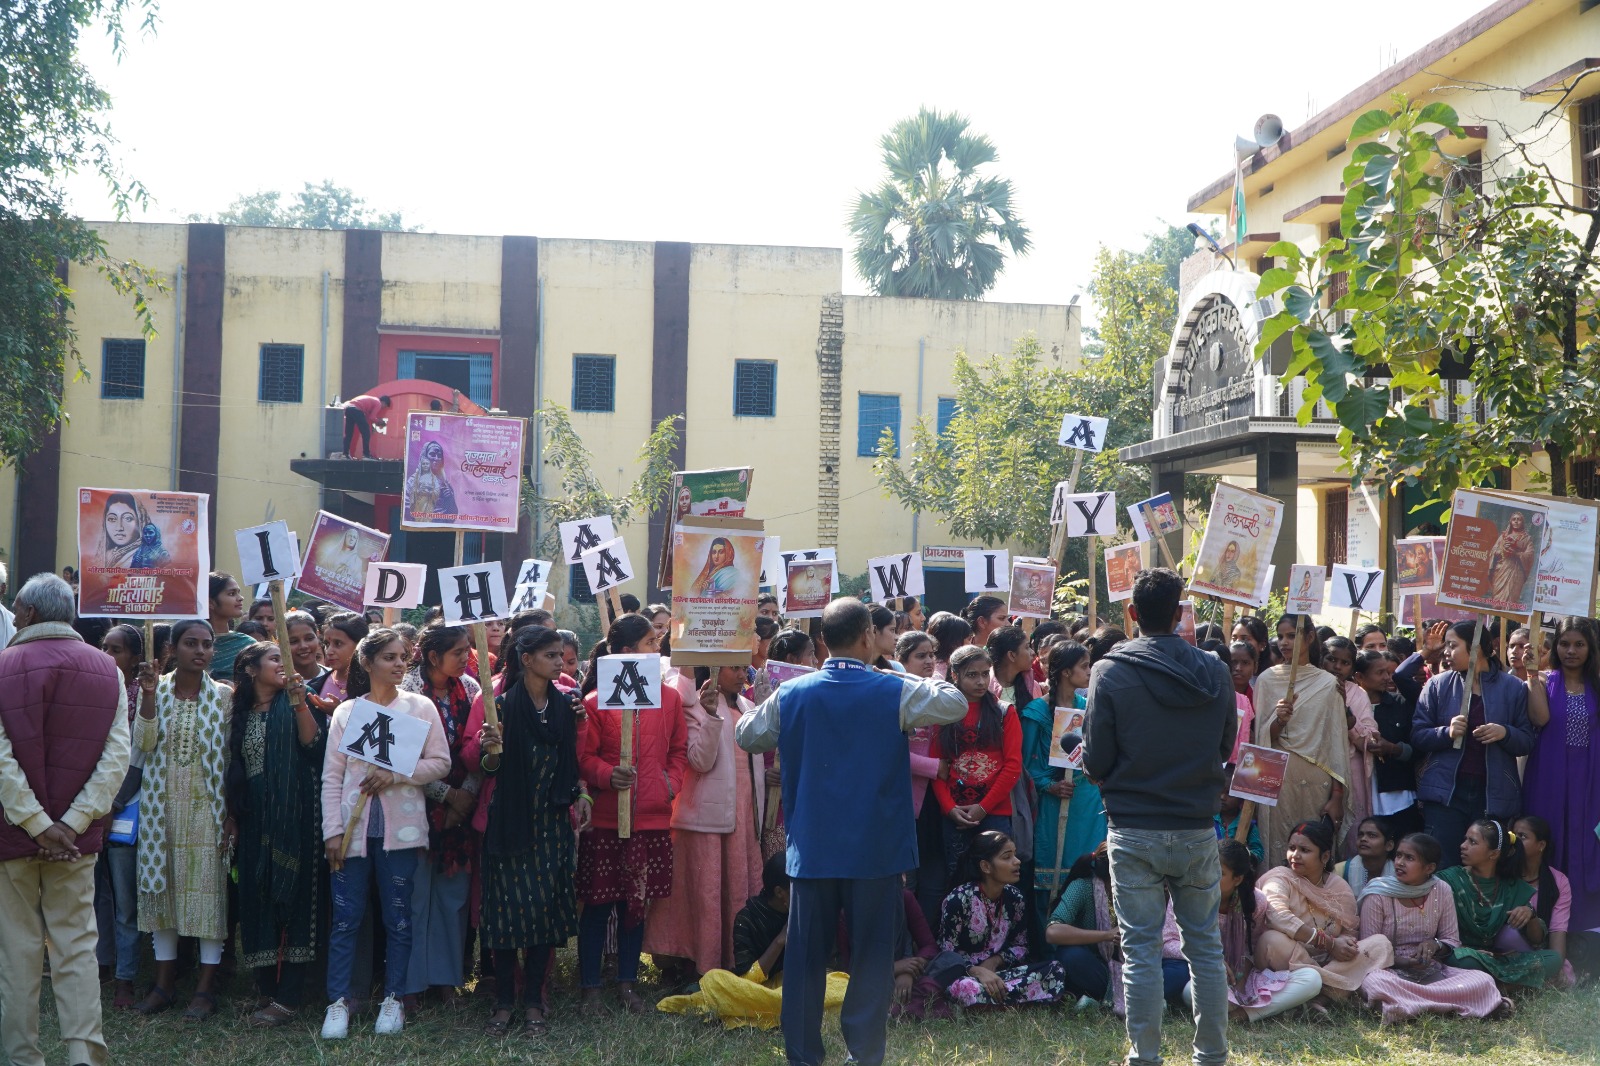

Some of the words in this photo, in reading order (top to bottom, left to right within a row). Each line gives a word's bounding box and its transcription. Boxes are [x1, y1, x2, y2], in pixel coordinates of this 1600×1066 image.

[1064, 419, 1097, 449] A
[465, 450, 497, 464] राजमाता
[1052, 487, 1063, 521] A
[1073, 493, 1110, 535] Y
[255, 531, 280, 577] I
[571, 524, 601, 560] A
[925, 547, 964, 558] प्राध्यापक
[125, 576, 157, 588] राजमाता
[374, 567, 407, 603] D
[520, 563, 540, 584] A
[596, 548, 629, 589] A
[873, 554, 912, 599] W
[984, 555, 998, 588] I
[107, 582, 165, 604] अहिल्याबाई
[453, 571, 498, 622] H
[513, 587, 537, 614] A
[1343, 570, 1381, 609] V
[125, 603, 156, 612] होळकर
[688, 628, 717, 637] अहिल्याबाई
[717, 628, 737, 637] होळकर
[605, 661, 654, 706] A
[346, 712, 395, 767] A
